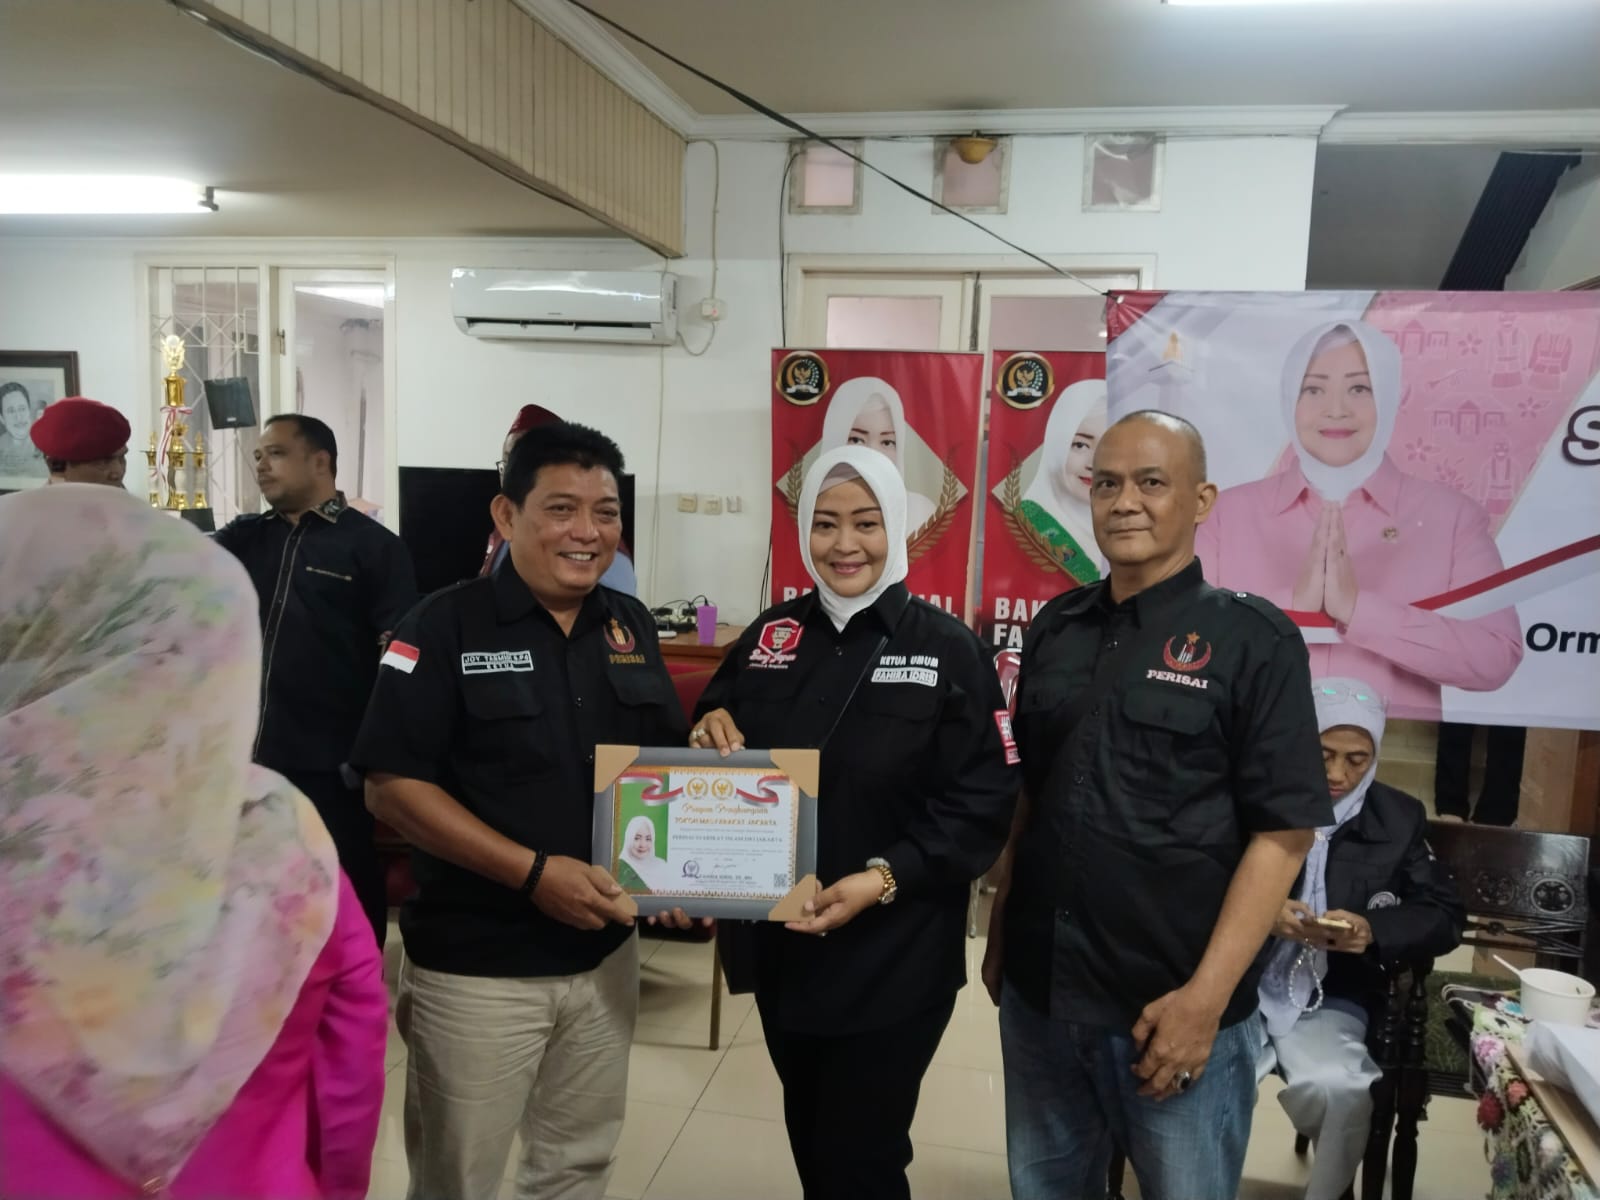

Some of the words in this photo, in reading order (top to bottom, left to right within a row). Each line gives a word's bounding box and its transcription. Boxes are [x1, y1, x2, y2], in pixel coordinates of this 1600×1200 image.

[880, 655, 907, 666] KETUA
[910, 655, 939, 668] UMUM
[1146, 669, 1208, 689] PERISAI
